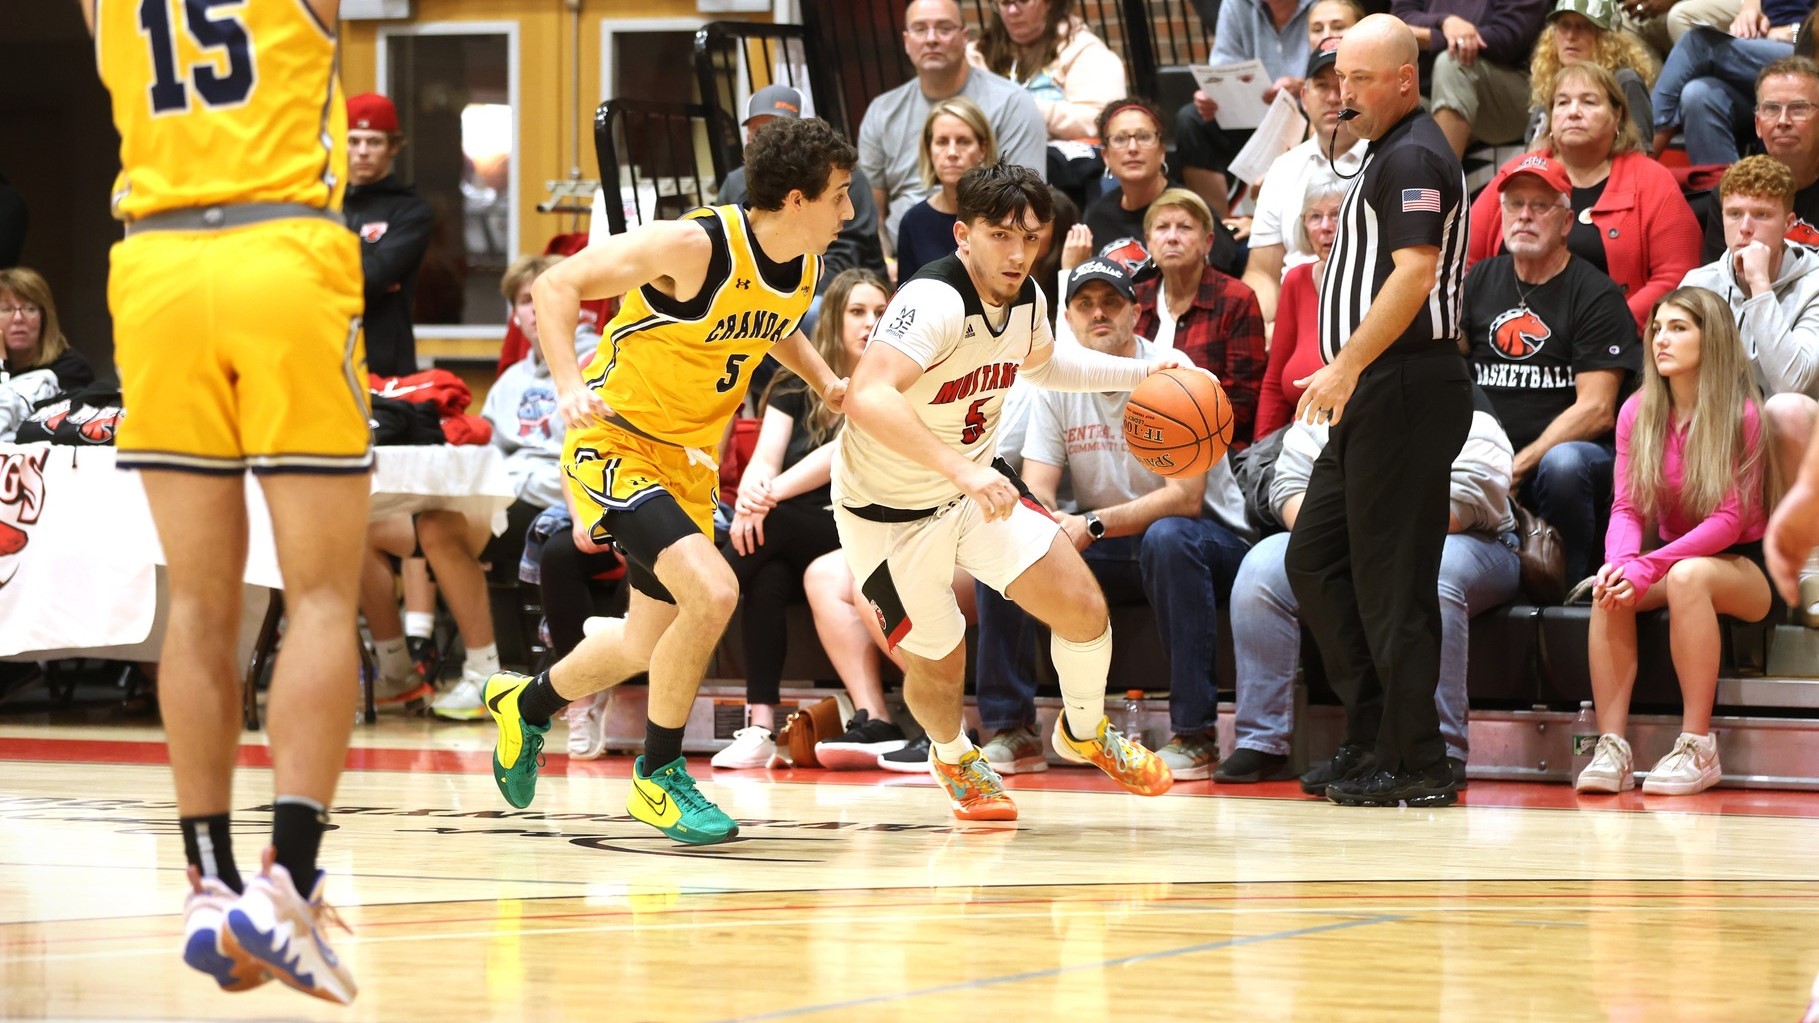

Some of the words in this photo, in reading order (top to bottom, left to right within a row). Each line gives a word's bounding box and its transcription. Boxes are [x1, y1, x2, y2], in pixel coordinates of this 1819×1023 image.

[139, 0, 257, 116] 15
[1071, 260, 1124, 282] Titleist
[716, 353, 750, 393] 5
[960, 396, 996, 445] 5
